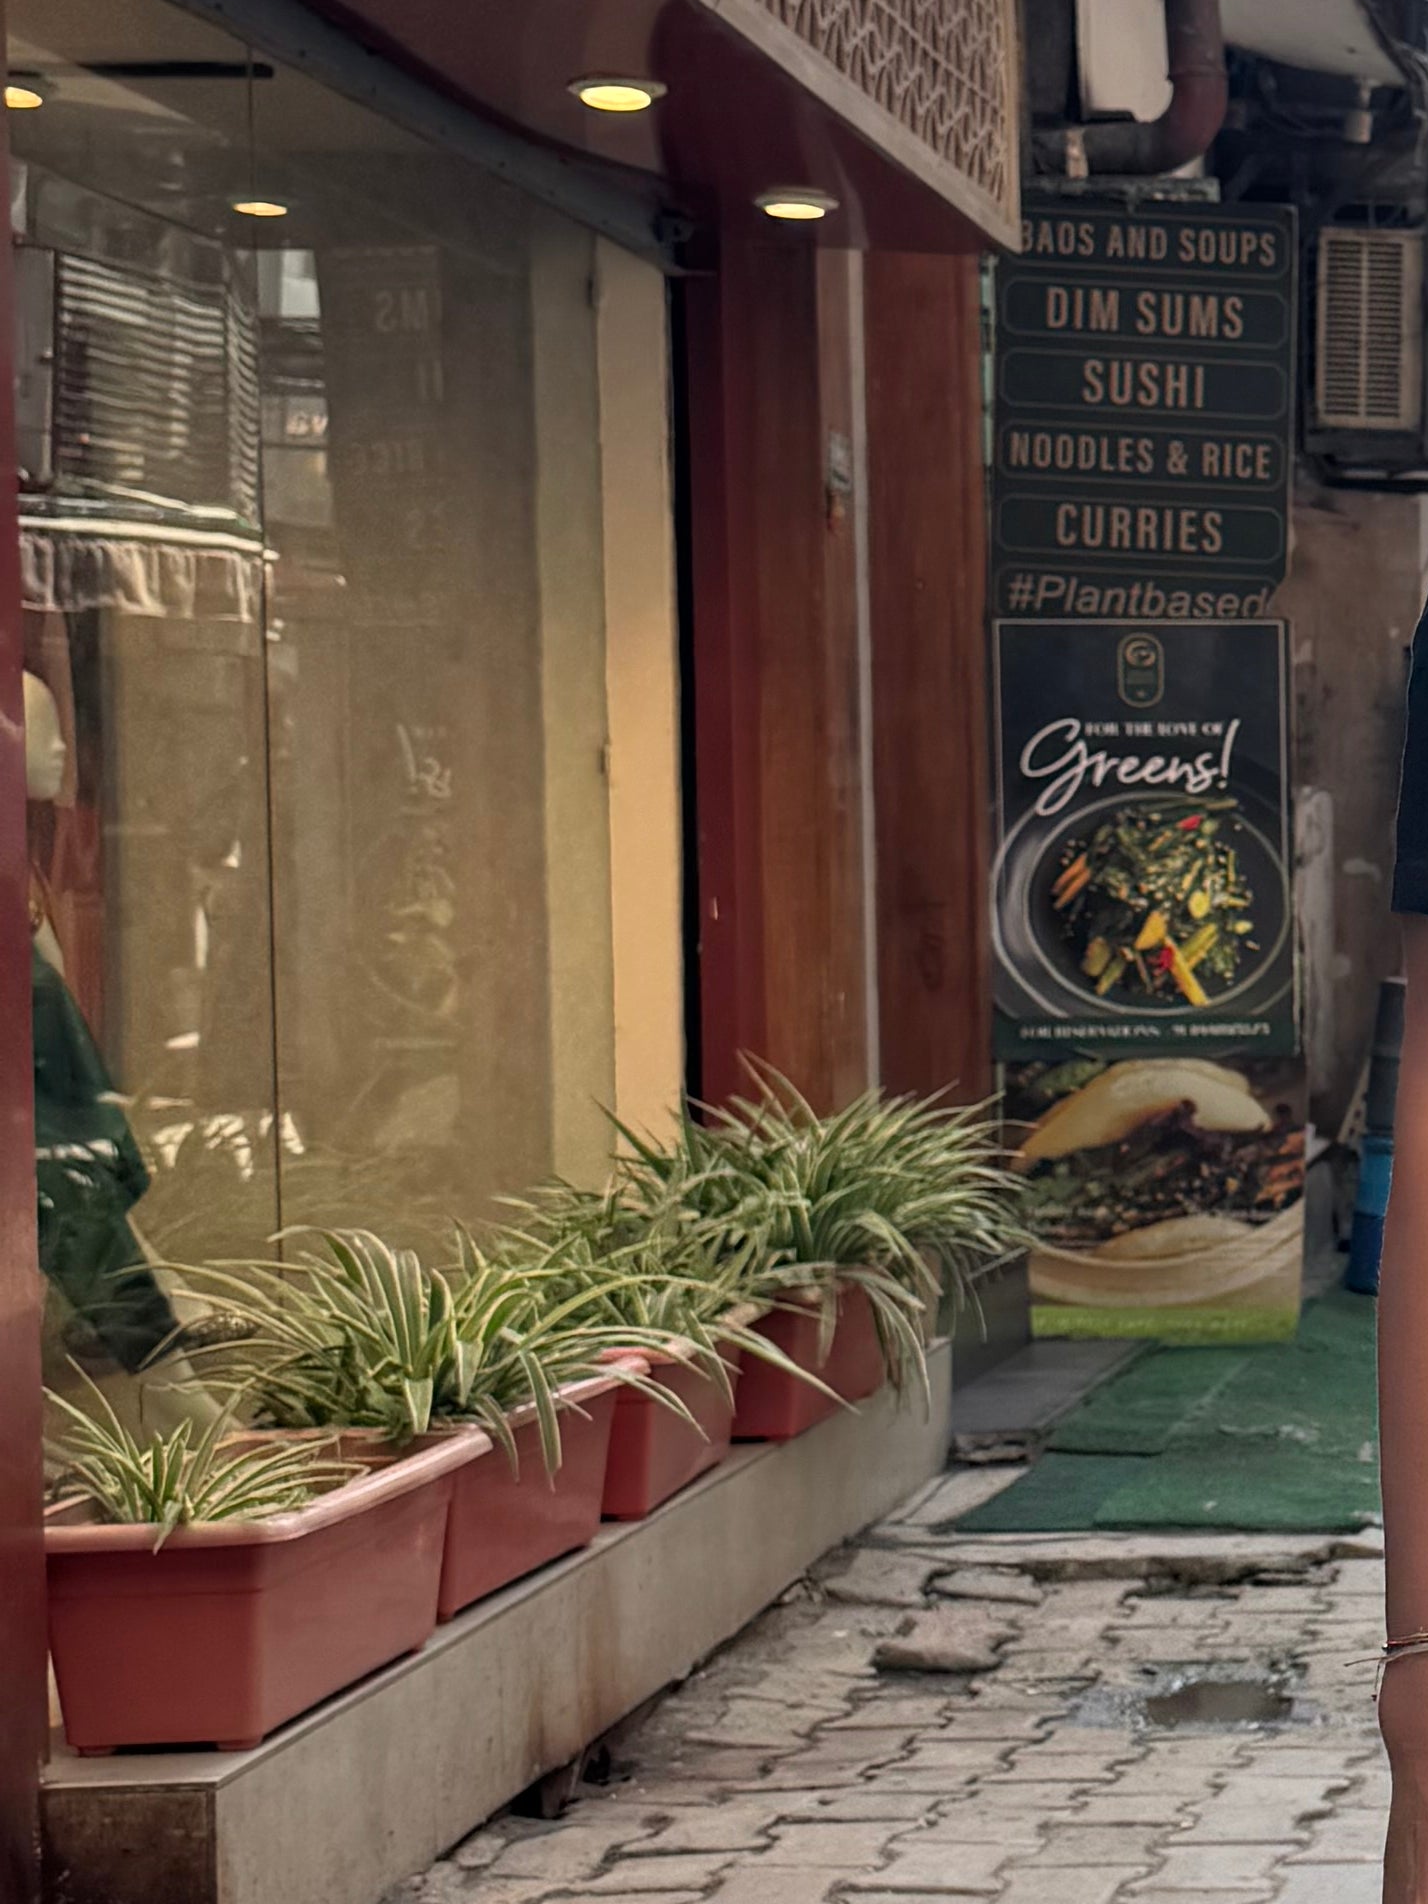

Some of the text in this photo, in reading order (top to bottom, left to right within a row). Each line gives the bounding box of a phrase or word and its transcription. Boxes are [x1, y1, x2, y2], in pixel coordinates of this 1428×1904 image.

[1021, 220, 1276, 267] BAOS AND SOUPS
[1046, 286, 1244, 340] DIM SUMS
[1082, 358, 1205, 409] SUSHI
[1009, 431, 1272, 480] NOODLES & RICE
[1055, 502, 1223, 553] CURRIES
[1008, 572, 1269, 618] #Plantbased
[1019, 716, 1241, 816] Greens!
